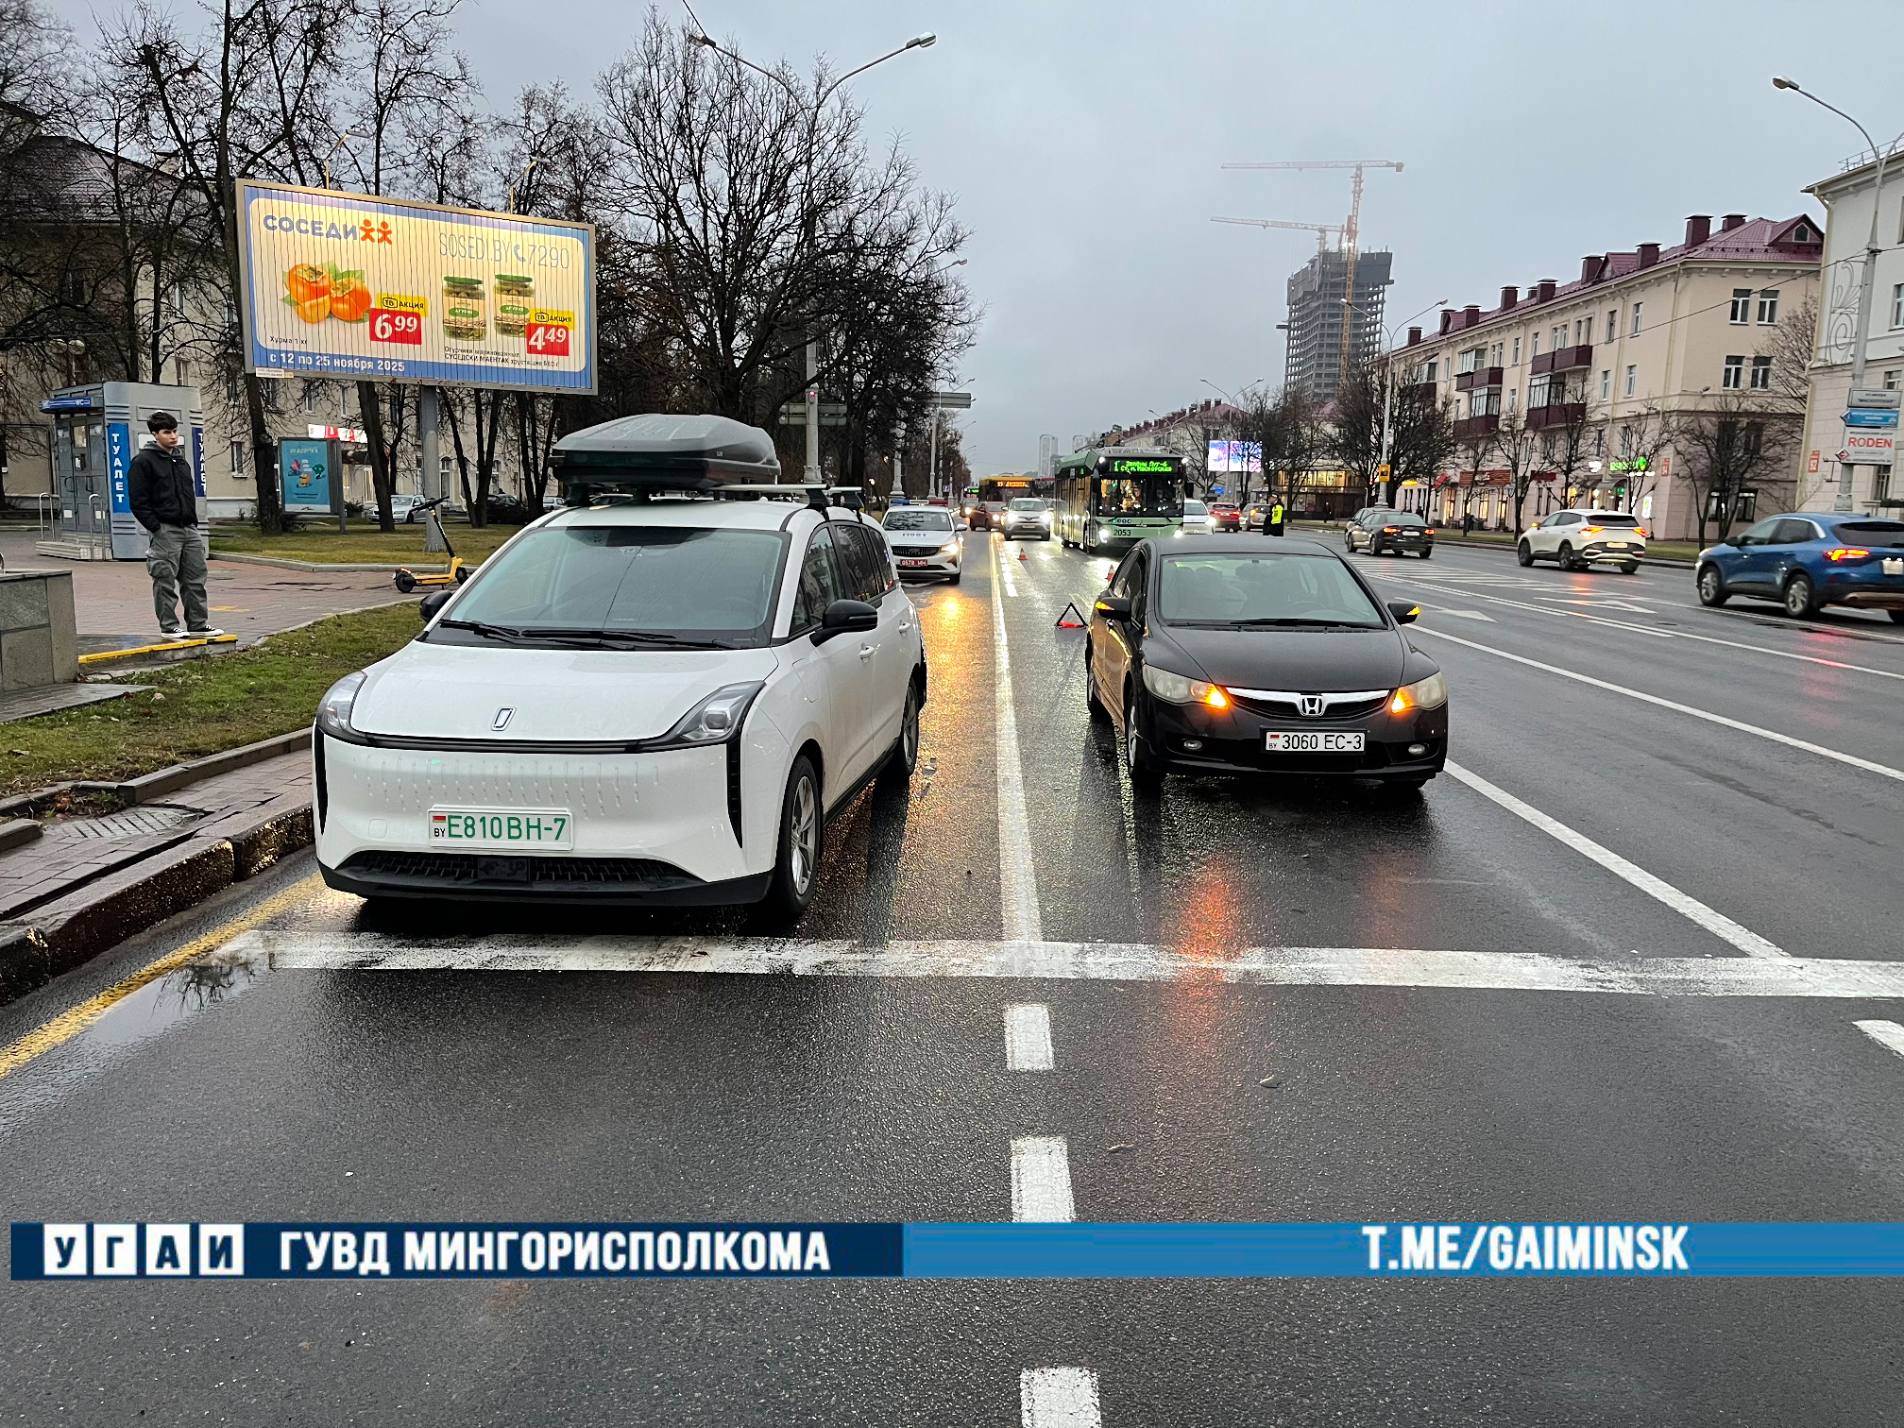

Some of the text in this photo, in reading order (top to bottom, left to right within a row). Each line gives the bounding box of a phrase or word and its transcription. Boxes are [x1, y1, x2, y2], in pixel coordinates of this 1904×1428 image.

[263, 214, 358, 241] СОСЕДИ
[439, 232, 570, 269] SOSEDI.BY 7290
[399, 301, 424, 309] АКЦИЯ
[270, 353, 405, 372] с 12 по 25 ноября 2025
[1847, 436, 1893, 449] RODEN
[111, 433, 125, 503] ТУАЛЕТ
[1113, 529, 1132, 537] 2053
[1281, 734, 1362, 750] 3060 EC-3
[433, 827, 446, 838] BY
